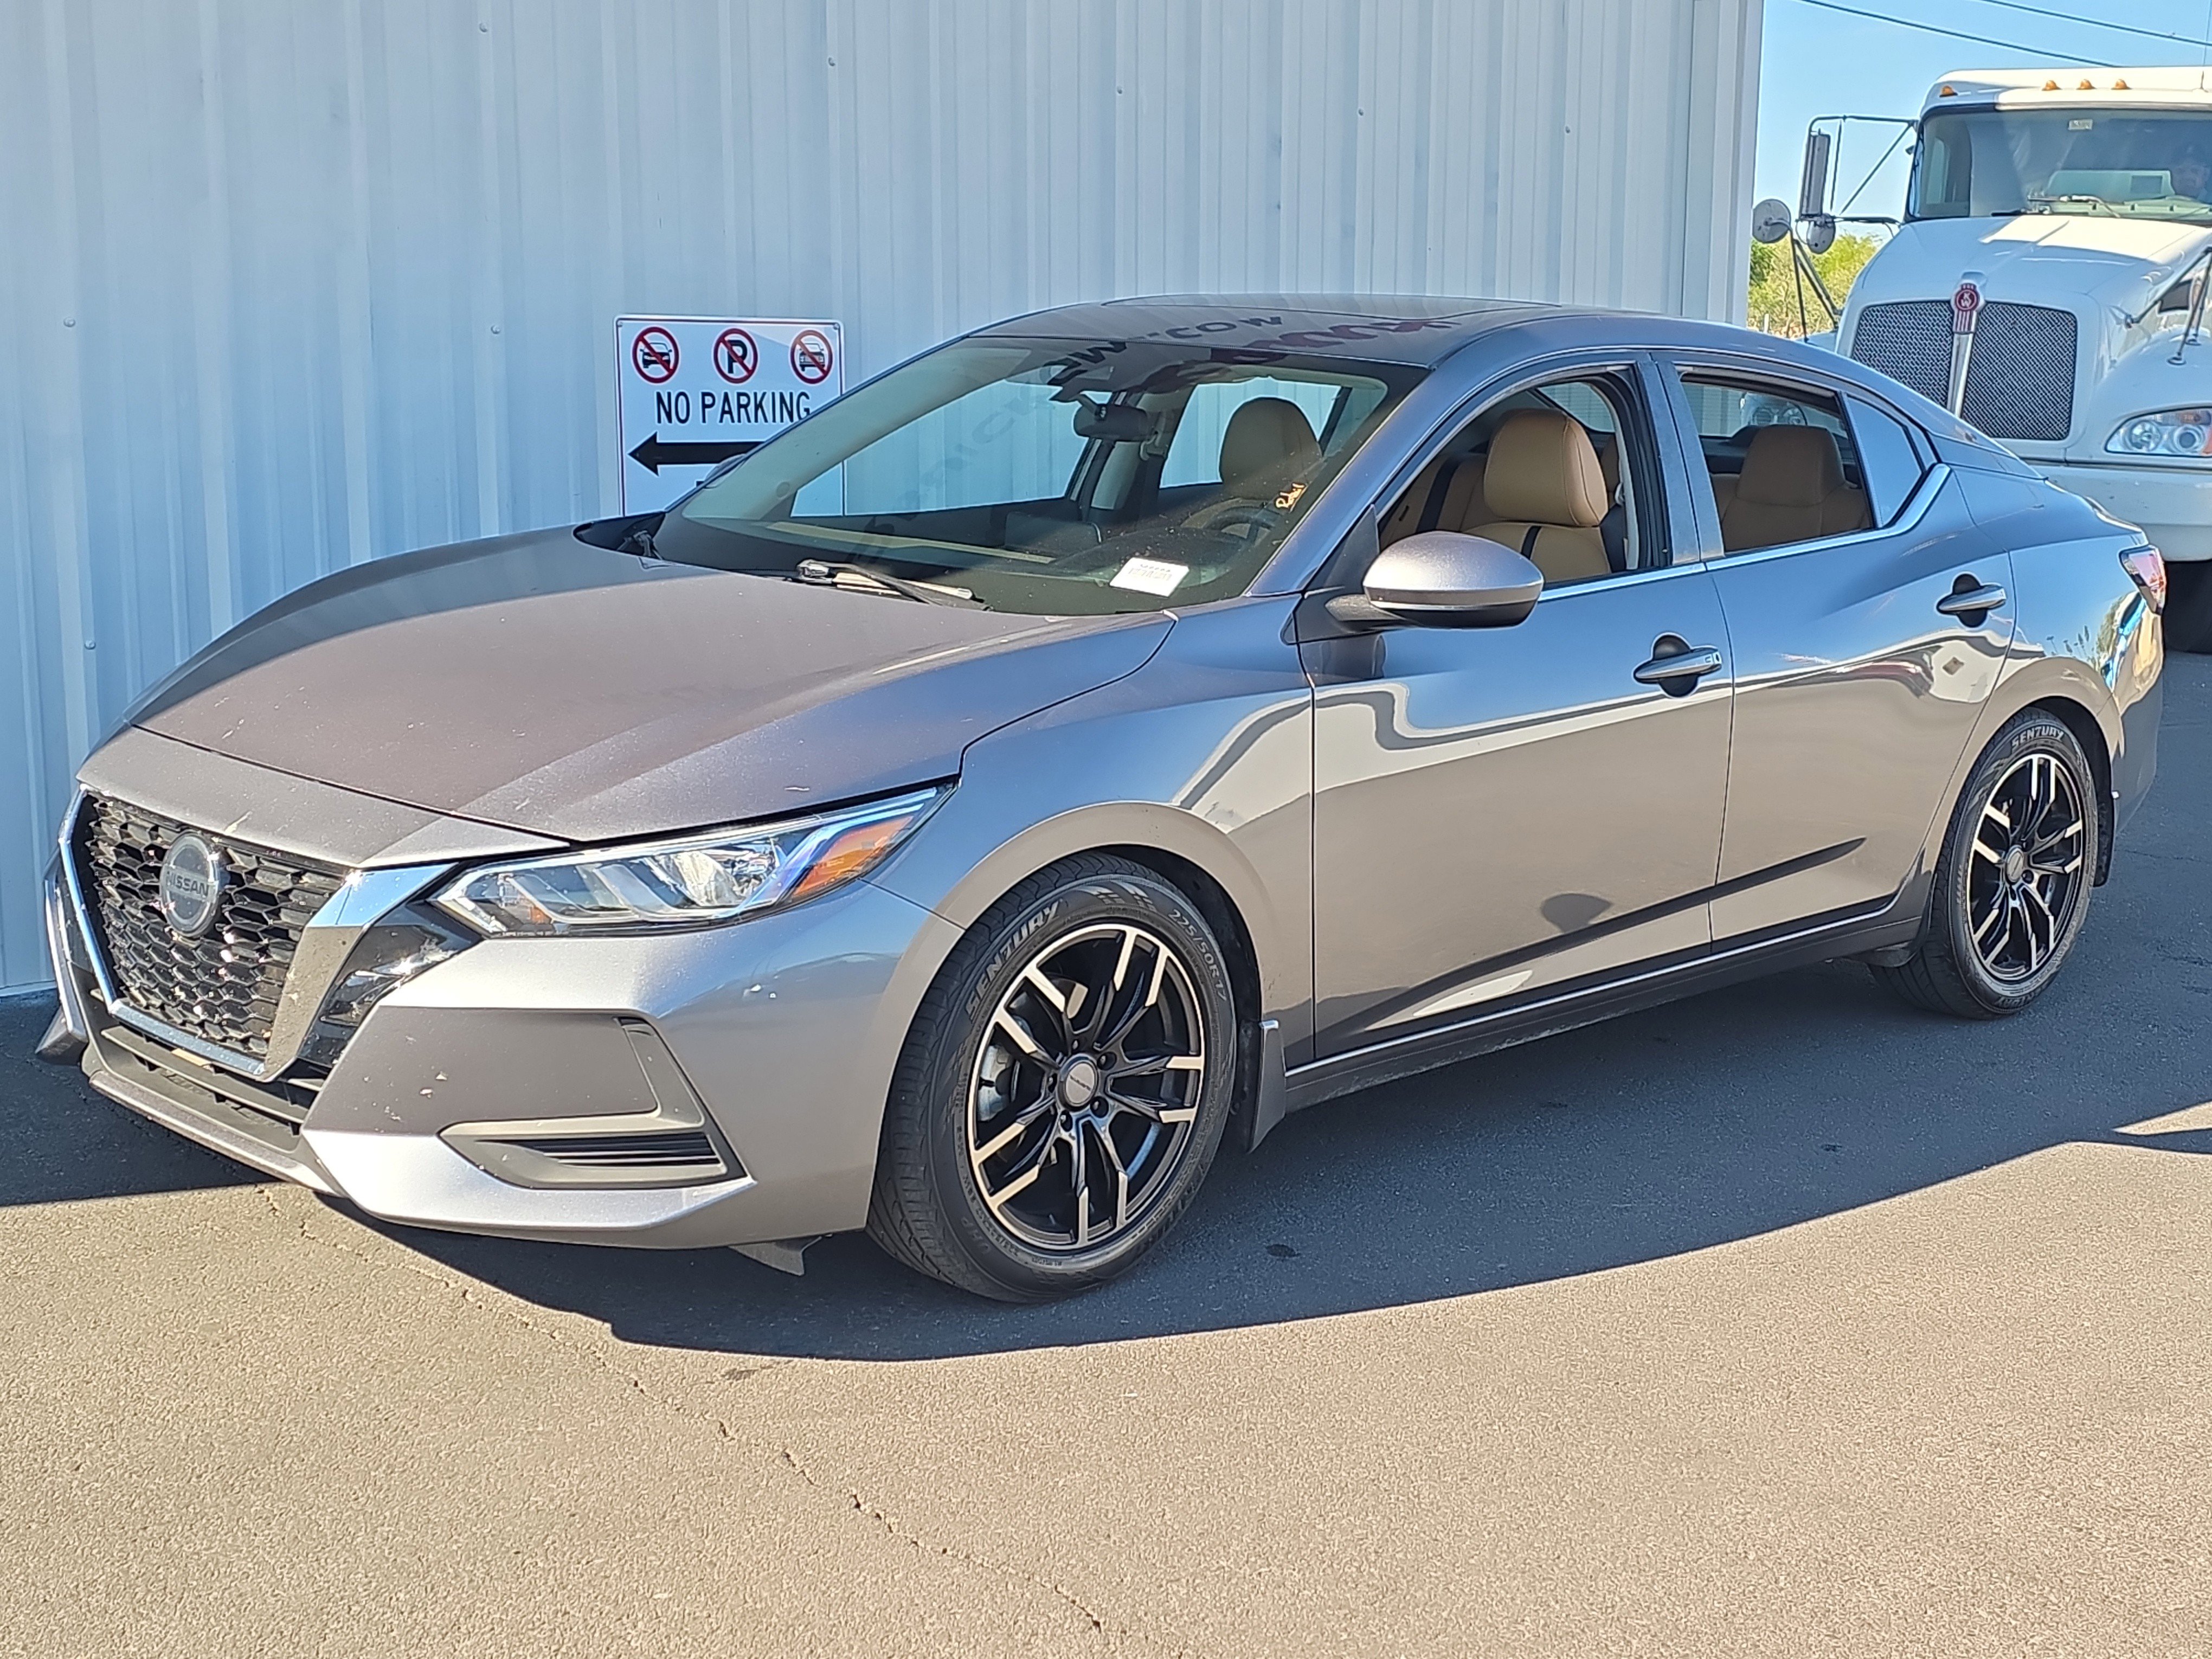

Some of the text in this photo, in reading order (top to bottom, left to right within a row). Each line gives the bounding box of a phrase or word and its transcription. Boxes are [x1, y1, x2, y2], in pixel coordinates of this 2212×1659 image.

[656, 391, 811, 424] NO PARKING
[2011, 725, 2064, 747] SENTURY
[166, 871, 209, 896] NISSAN
[965, 901, 1059, 1023] SENTURY
